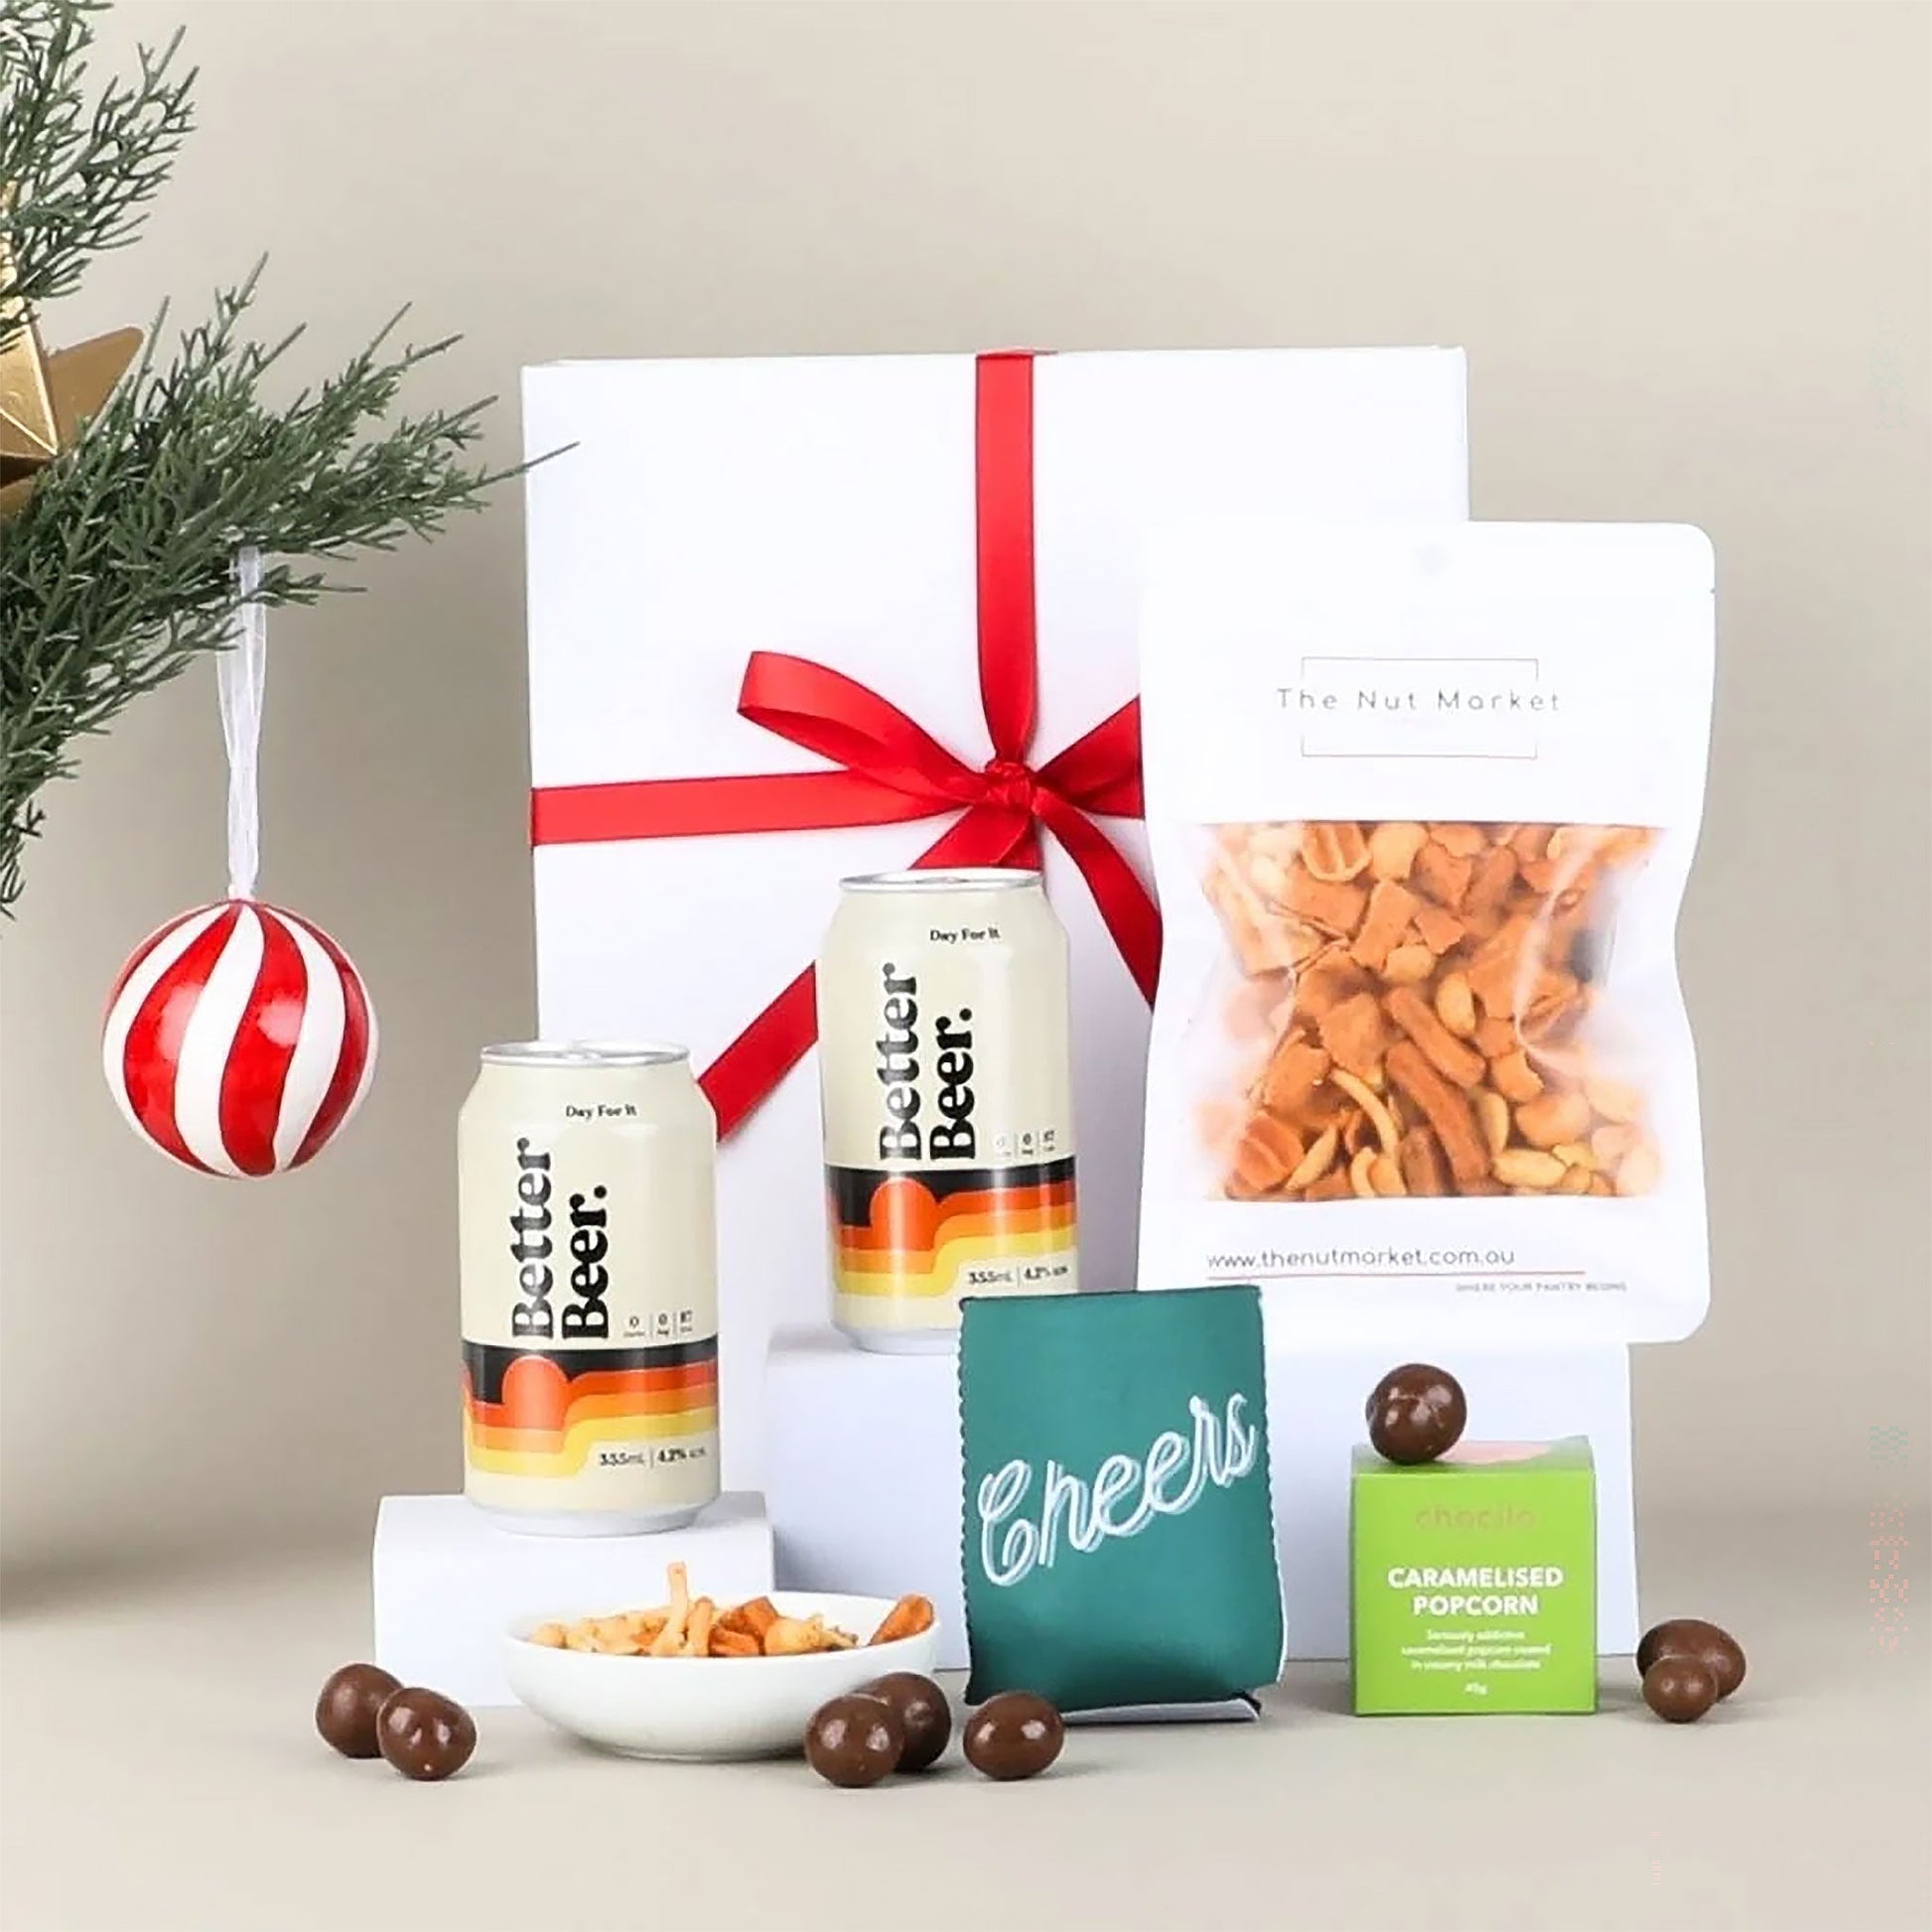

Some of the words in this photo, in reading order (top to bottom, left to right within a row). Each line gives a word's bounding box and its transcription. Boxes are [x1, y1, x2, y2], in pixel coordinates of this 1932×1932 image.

[1278, 687, 1337, 710] The
[1357, 689, 1417, 711] Nut
[1438, 689, 1560, 712] Market
[929, 928, 957, 944] Day
[961, 927, 986, 941] For
[876, 962, 922, 1161] Better
[929, 1008, 976, 1161] Beer.
[565, 1105, 594, 1121] Day
[598, 1103, 622, 1117] For
[509, 1137, 554, 1340] Better
[561, 1184, 610, 1340] Beer.
[1206, 1245, 1515, 1269] www.thenutmarket.com.au
[978, 1392, 1259, 1587] Cheers
[1388, 1566, 1564, 1588] CARAMELISED
[1413, 1594, 1538, 1616] POPCORN
